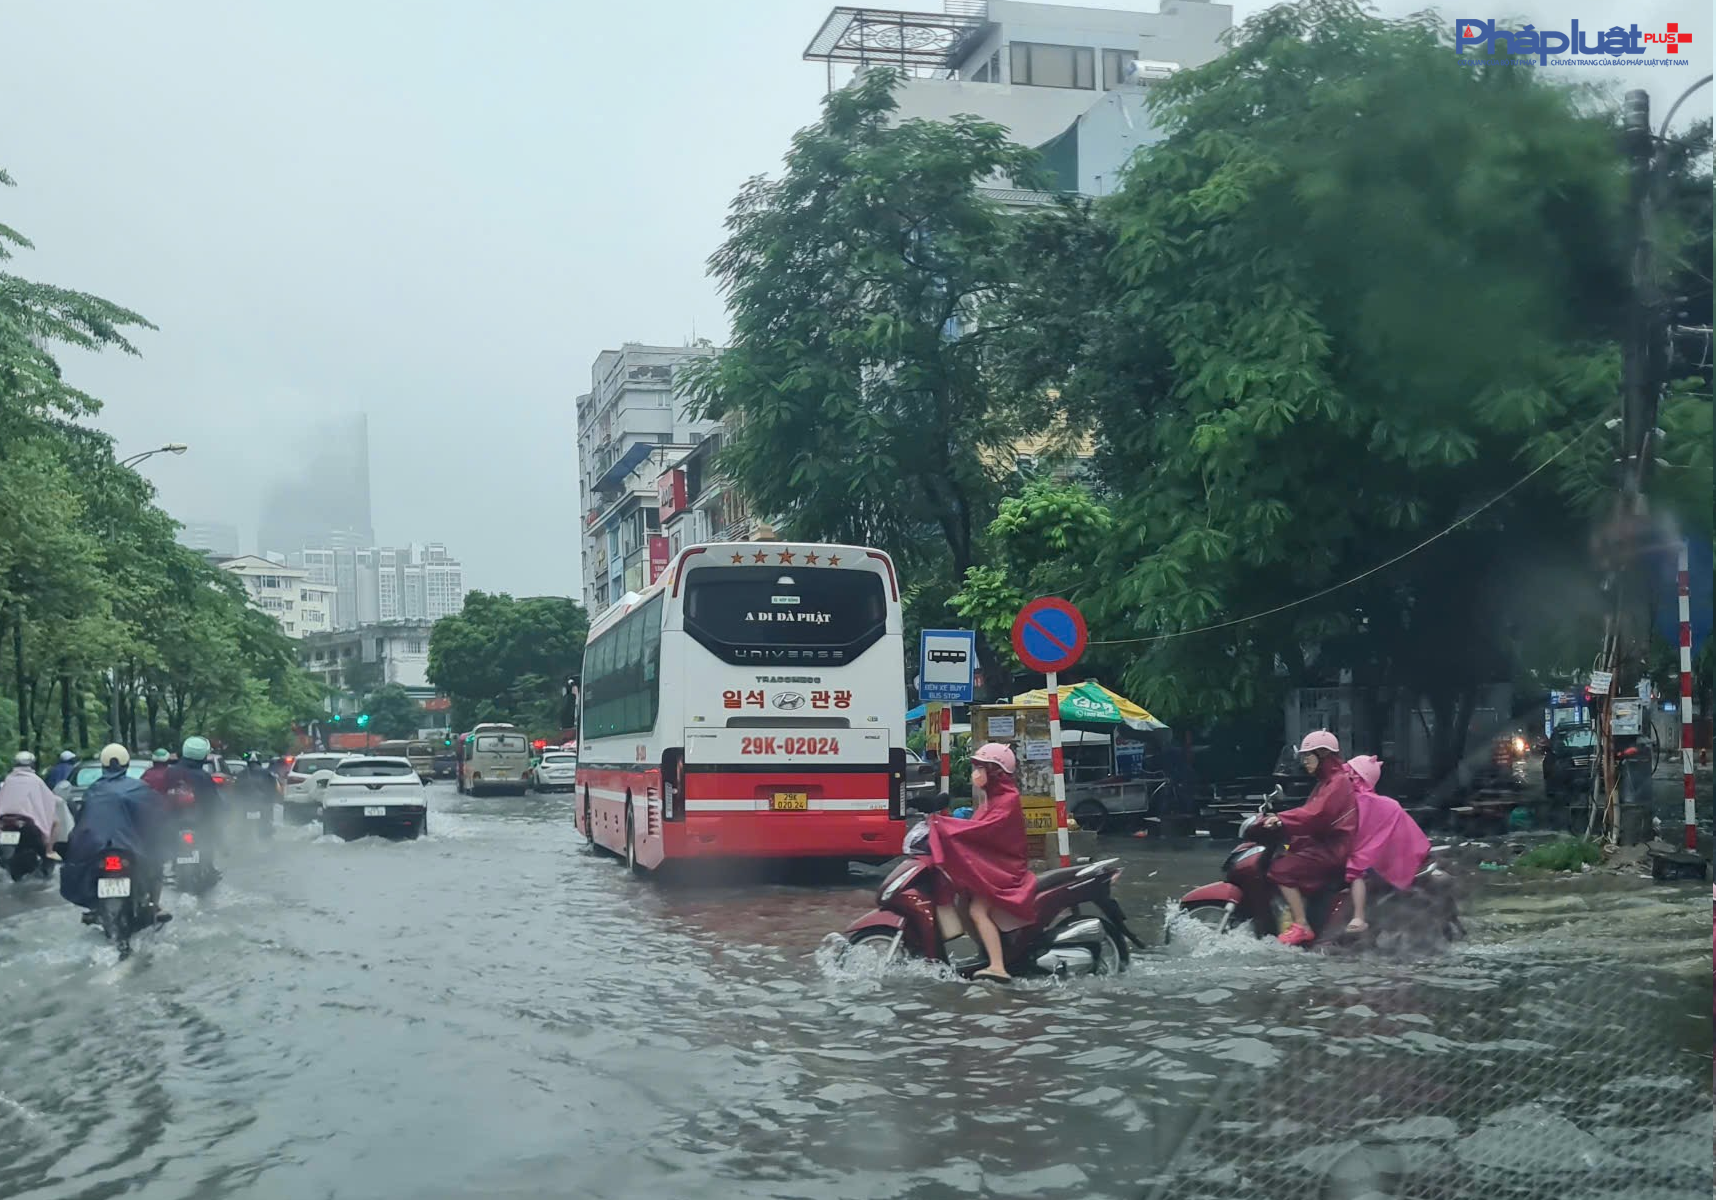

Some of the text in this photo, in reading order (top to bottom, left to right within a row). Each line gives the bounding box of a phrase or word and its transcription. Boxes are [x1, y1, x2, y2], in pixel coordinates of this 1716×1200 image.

[745, 611, 754, 621] A
[758, 611, 773, 621] DI
[797, 611, 832, 624] PHẬT
[734, 649, 844, 658] UNIVERSE
[722, 689, 853, 709] 일석 관광
[943, 692, 961, 700] STOP
[741, 736, 840, 756] 29K-02024
